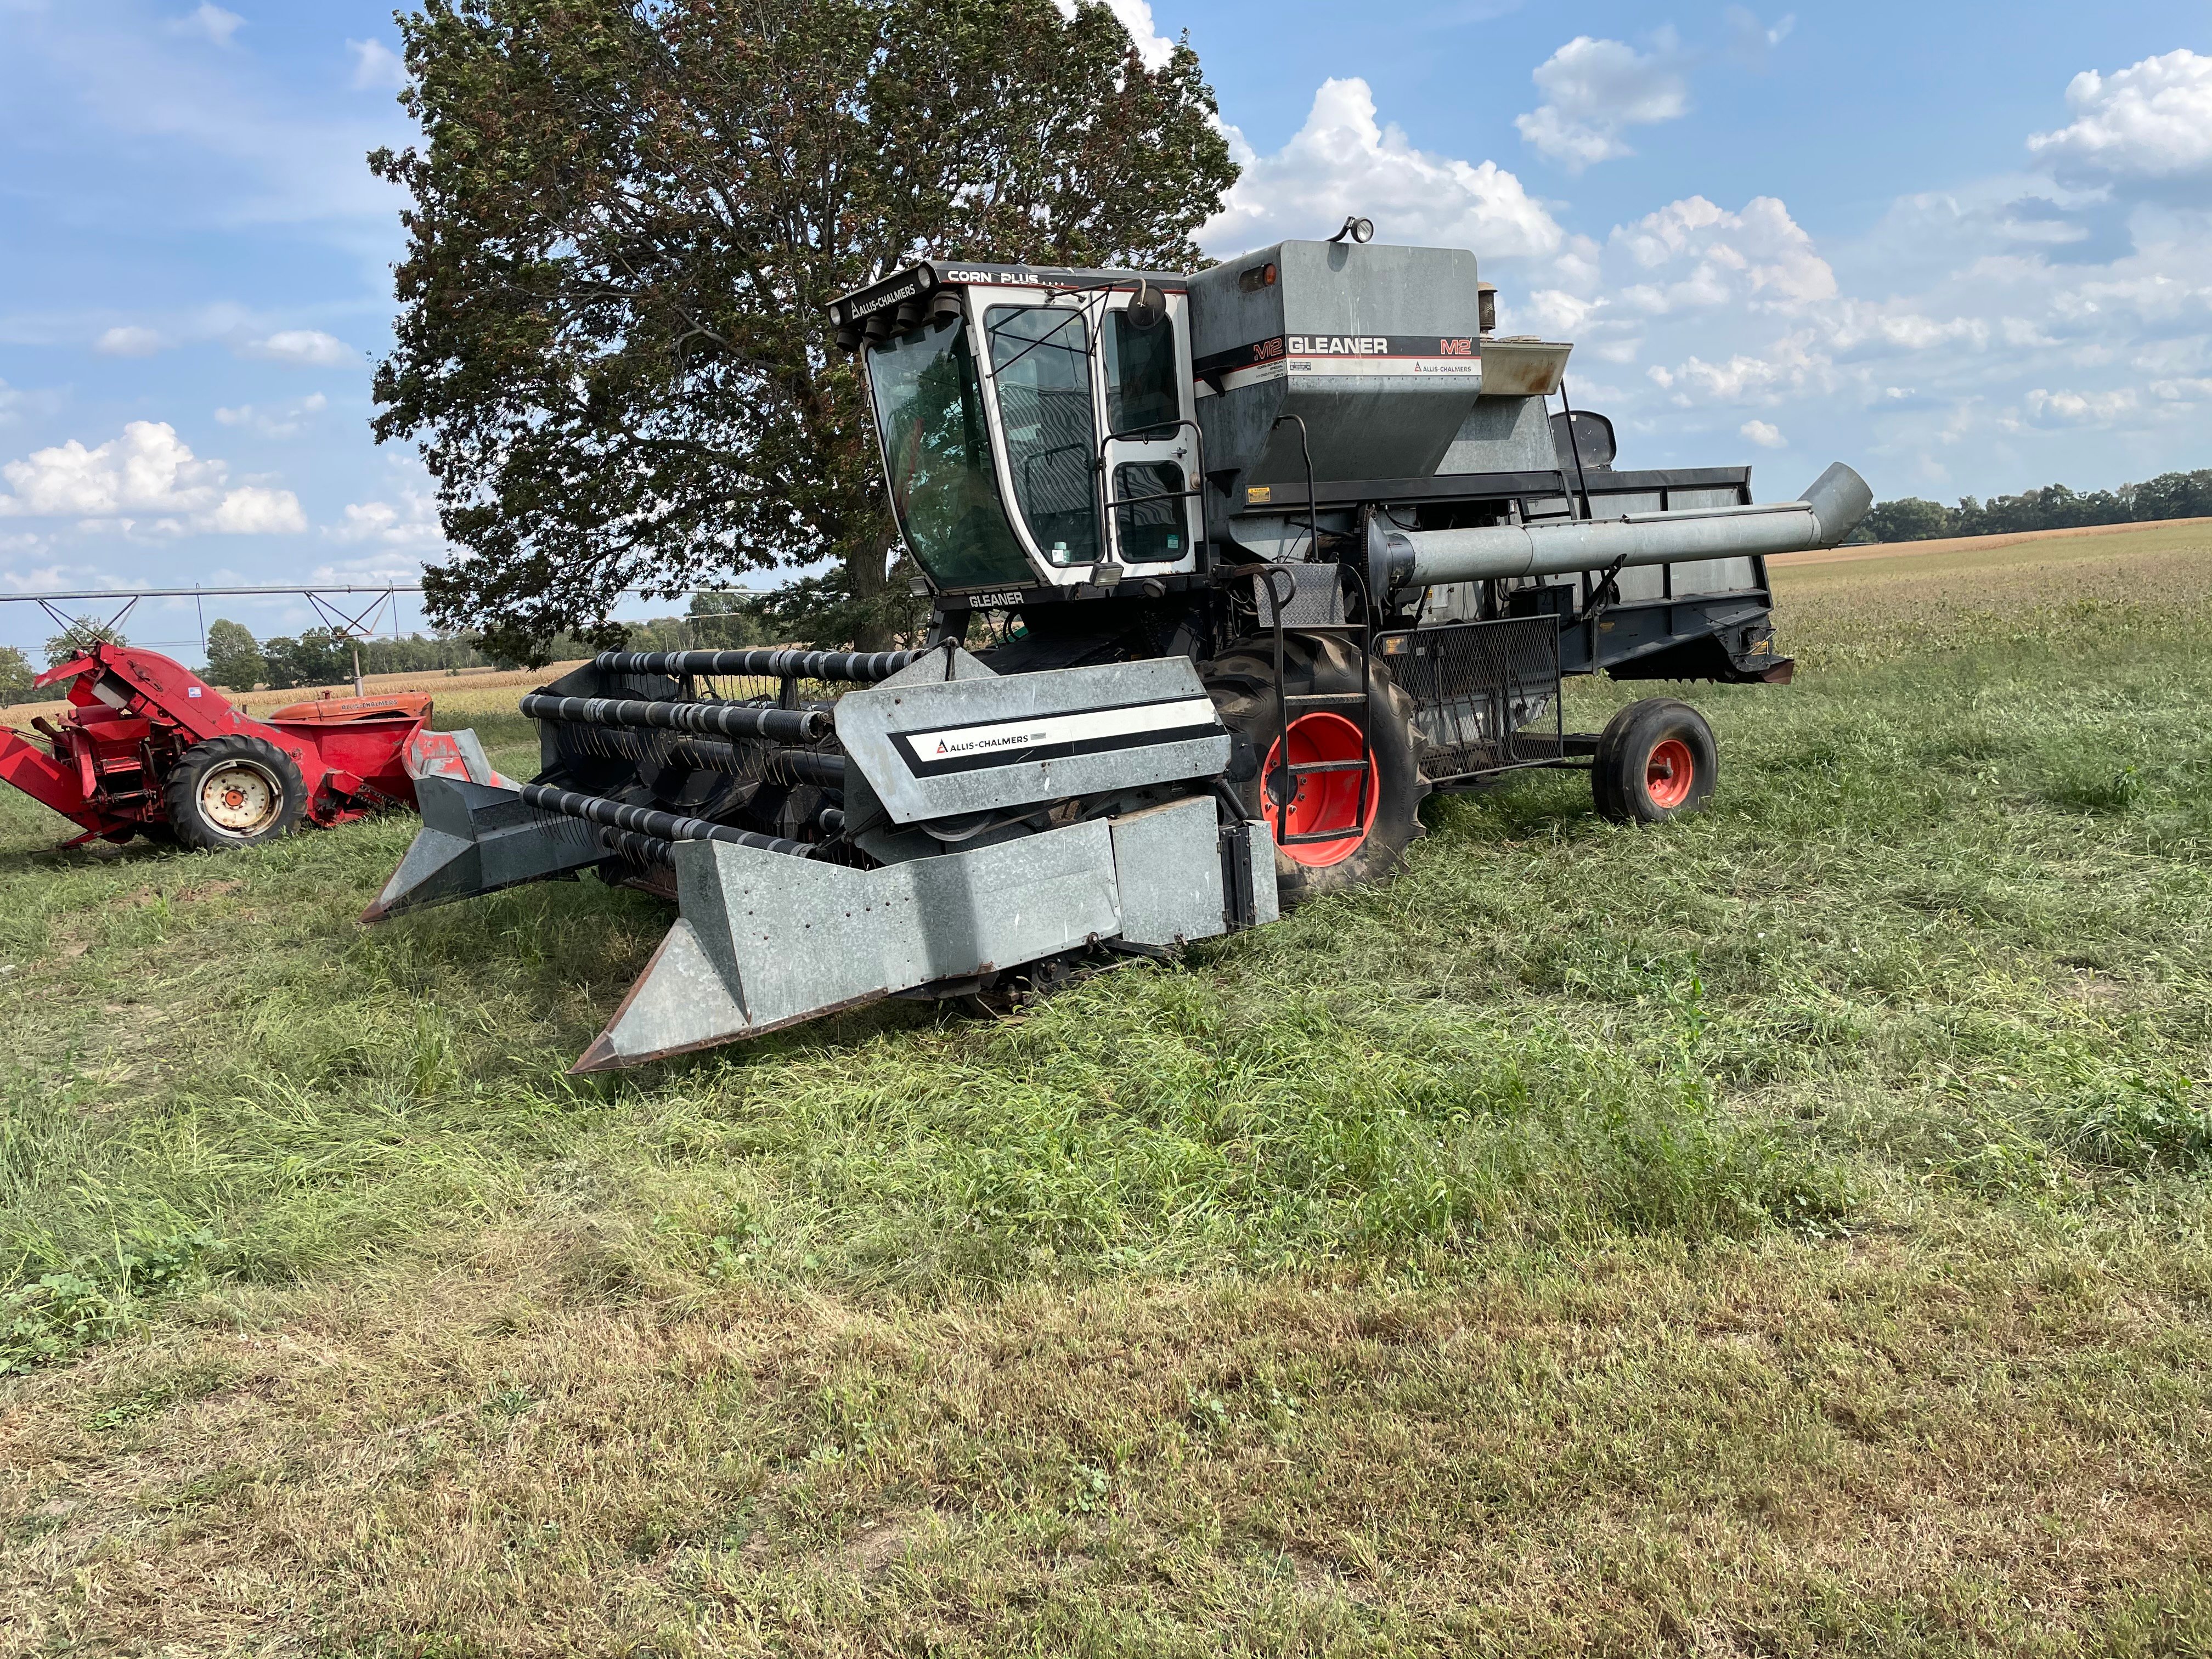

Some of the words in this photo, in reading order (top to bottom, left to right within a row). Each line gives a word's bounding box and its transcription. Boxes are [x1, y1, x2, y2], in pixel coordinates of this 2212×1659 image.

[948, 270, 991, 283] CORN
[859, 284, 916, 316] ALLIS-CHALMERS
[1253, 338, 1283, 361] M2
[1288, 337, 1388, 354] GLEANER
[1440, 339, 1471, 355] M2
[969, 591, 1024, 607] GLEANER
[342, 699, 398, 710] ALLIS-CHALMERS
[950, 735, 1029, 753] ALLIS-CHALMERS
